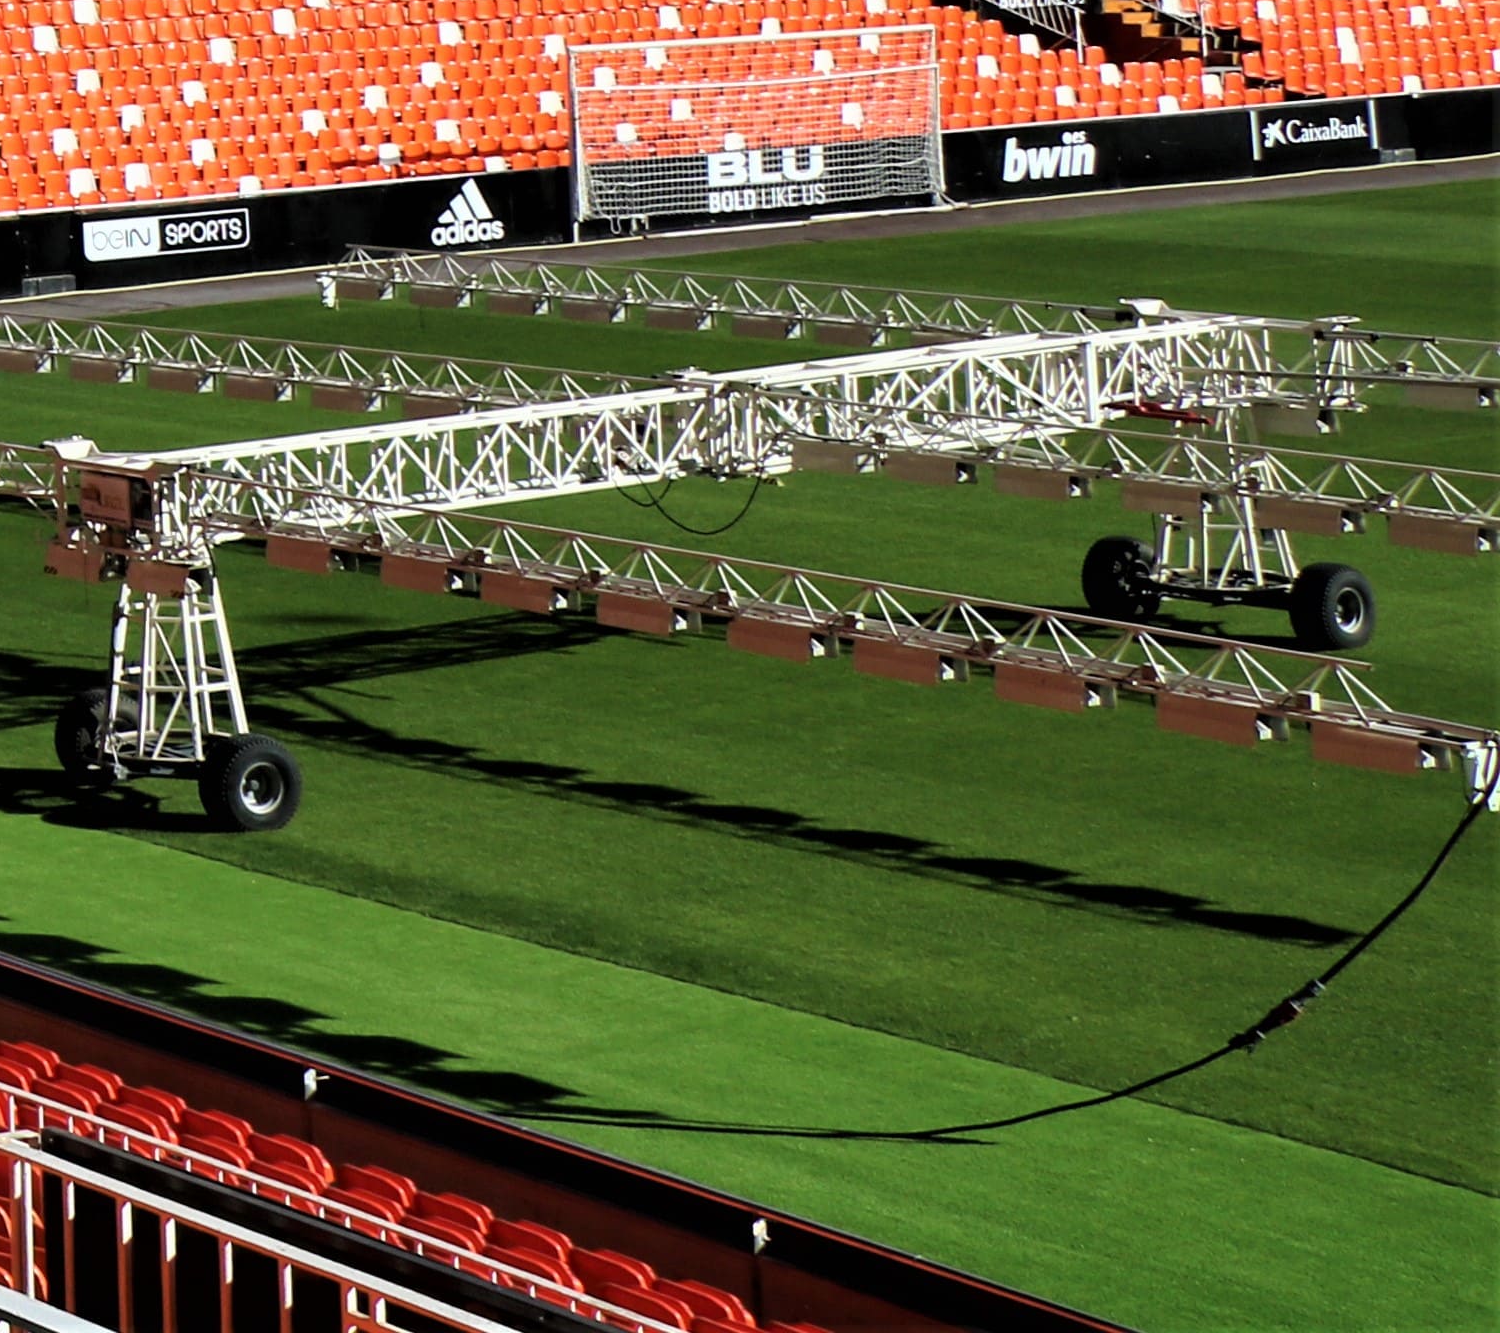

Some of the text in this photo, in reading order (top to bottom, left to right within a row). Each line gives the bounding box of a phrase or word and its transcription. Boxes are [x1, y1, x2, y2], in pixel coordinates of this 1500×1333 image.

[1285, 115, 1368, 144] CaixaBank
[709, 183, 826, 213] BOLD LIKE US
[165, 217, 243, 247] SPORTS
[431, 217, 504, 246] adidas
